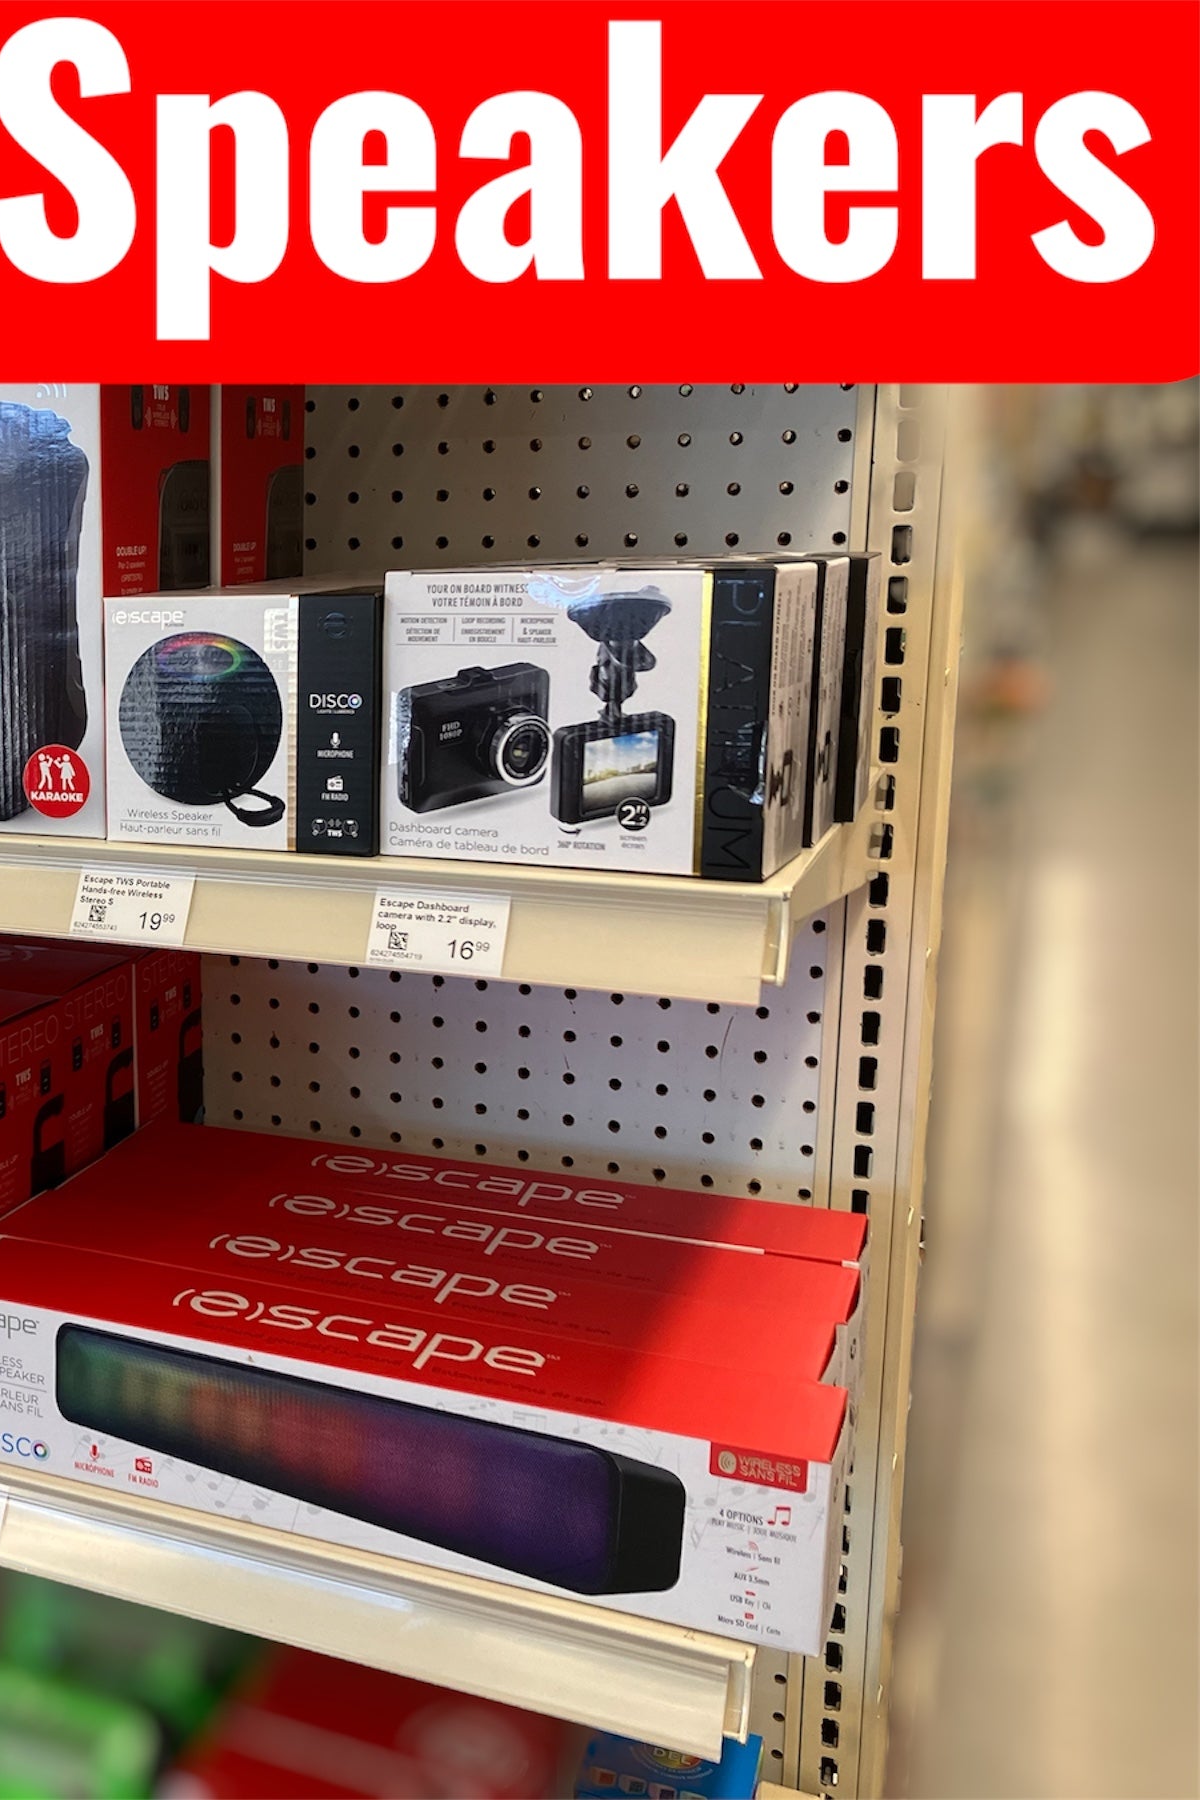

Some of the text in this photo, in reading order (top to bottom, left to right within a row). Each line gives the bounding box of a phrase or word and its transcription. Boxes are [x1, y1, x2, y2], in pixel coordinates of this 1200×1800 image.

[427, 584, 491, 594] YOUR ON BOARD
[432, 597, 523, 607] VOTRE TÉMOIN BORD
[309, 694, 362, 709] DISCO
[317, 750, 353, 758] MICROPHONE
[31, 791, 83, 803] KARAOKE
[127, 809, 213, 823] Wireless Speaker
[120, 823, 221, 836] Haut-parleur sans fil
[389, 821, 498, 837] Dashboard camera
[389, 835, 549, 856] Caméra de tableau de bord
[84, 874, 170, 889] Escape TWS Portable
[80, 895, 106, 905] Stereo
[82, 886, 163, 899] Hands-free Wireless
[380, 898, 469, 913] Escape Dashboard
[378, 911, 413, 921] camera
[416, 913, 436, 922] with
[376, 921, 397, 931] loop
[64, 975, 127, 1030] STEREO
[91, 1024, 103, 1040] TWS
[16, 1068, 31, 1086] TWS
[27, 1406, 43, 1418] FIL
[74, 1461, 114, 1478] MICROPHONE
[738, 1454, 801, 1477] WIRELESS
[128, 1473, 158, 1488] FM RADIO
[740, 1465, 798, 1487] SANS FIL
[719, 1509, 763, 1526] 4 OPTIONS
